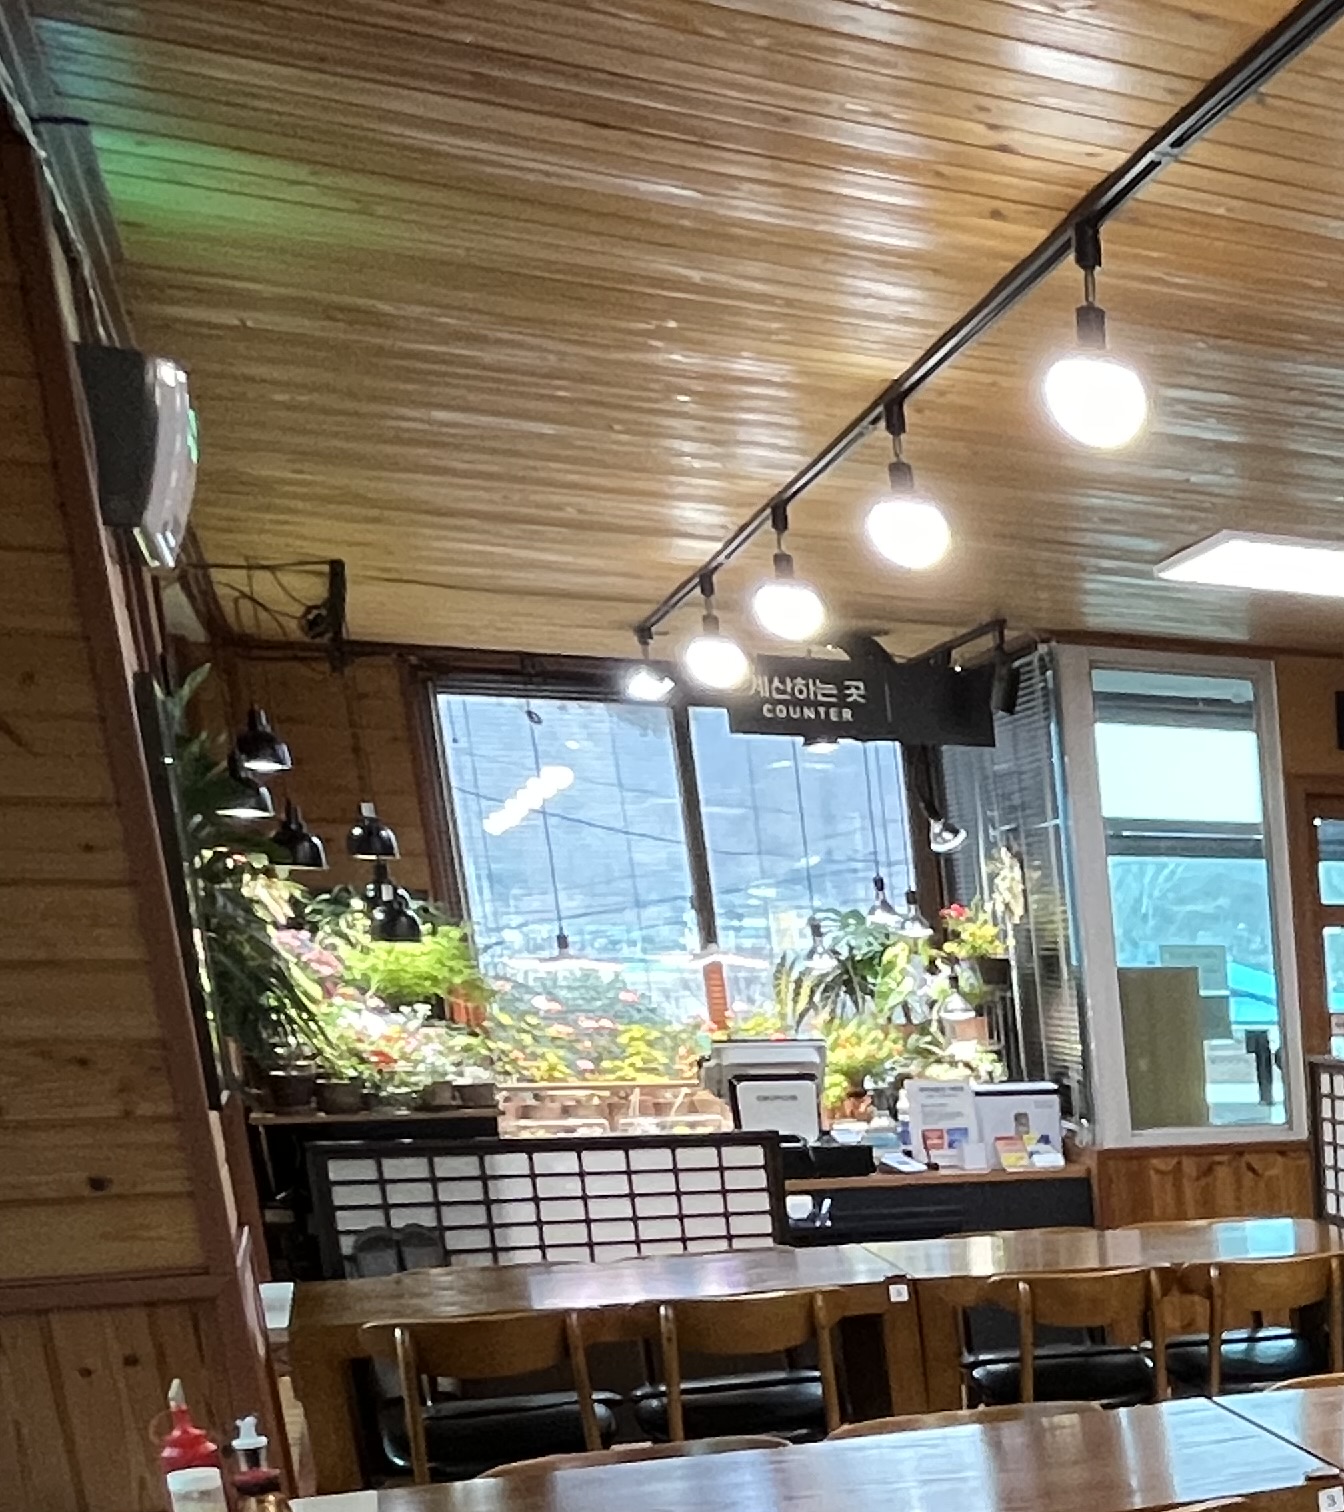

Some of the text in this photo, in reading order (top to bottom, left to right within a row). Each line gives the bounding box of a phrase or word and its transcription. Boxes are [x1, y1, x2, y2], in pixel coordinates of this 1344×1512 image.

[843, 680, 867, 703] 곳
[762, 703, 854, 722] COUNTER
[1327, 1494, 1336, 1507] 3
